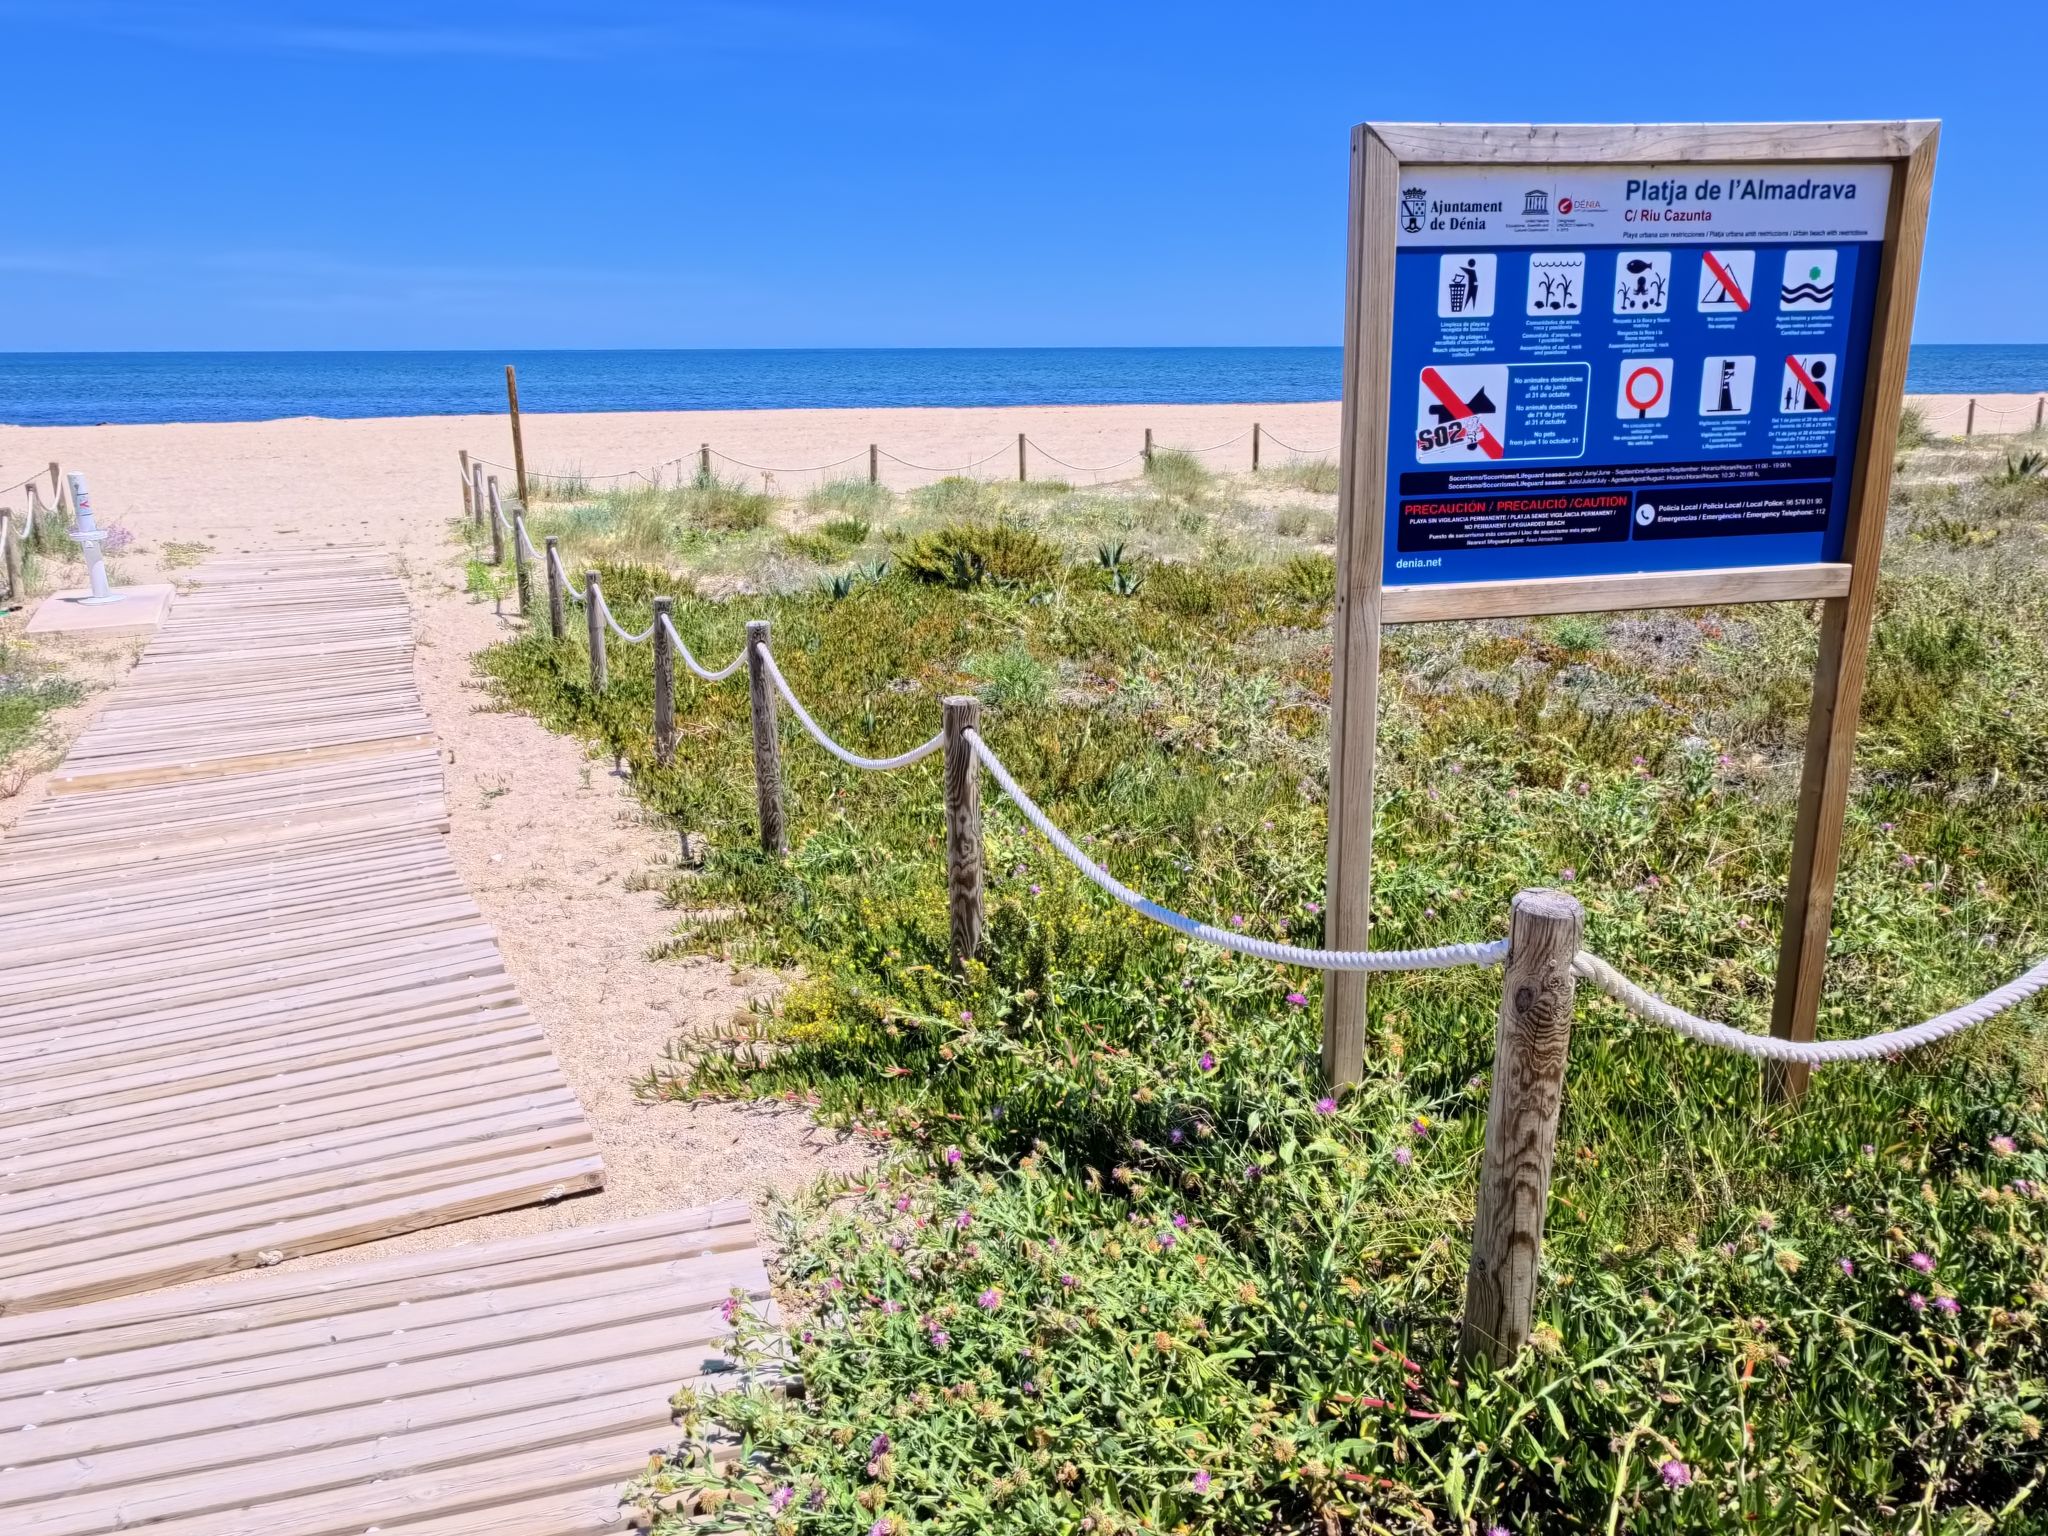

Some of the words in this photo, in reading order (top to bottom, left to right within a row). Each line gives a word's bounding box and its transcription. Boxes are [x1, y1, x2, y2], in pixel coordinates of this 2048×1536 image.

[1626, 180, 1687, 205] Platja
[1695, 180, 1721, 200] de
[1729, 180, 1856, 200] l'Almadrava
[1431, 200, 1502, 216] Ajuntament
[1625, 210, 1637, 222] C/
[1641, 209, 1660, 221] Riu
[1665, 209, 1712, 221] Cazunta
[1431, 218, 1445, 230] de
[1450, 217, 1486, 230] Dénia
[1405, 500, 1486, 515] PRECAUCIÓN
[1489, 502, 1494, 512] /
[1498, 497, 1567, 511] PRECAUCIÓ
[1746, 511, 1780, 519] Emergency
[1397, 557, 1441, 568] denia.net
